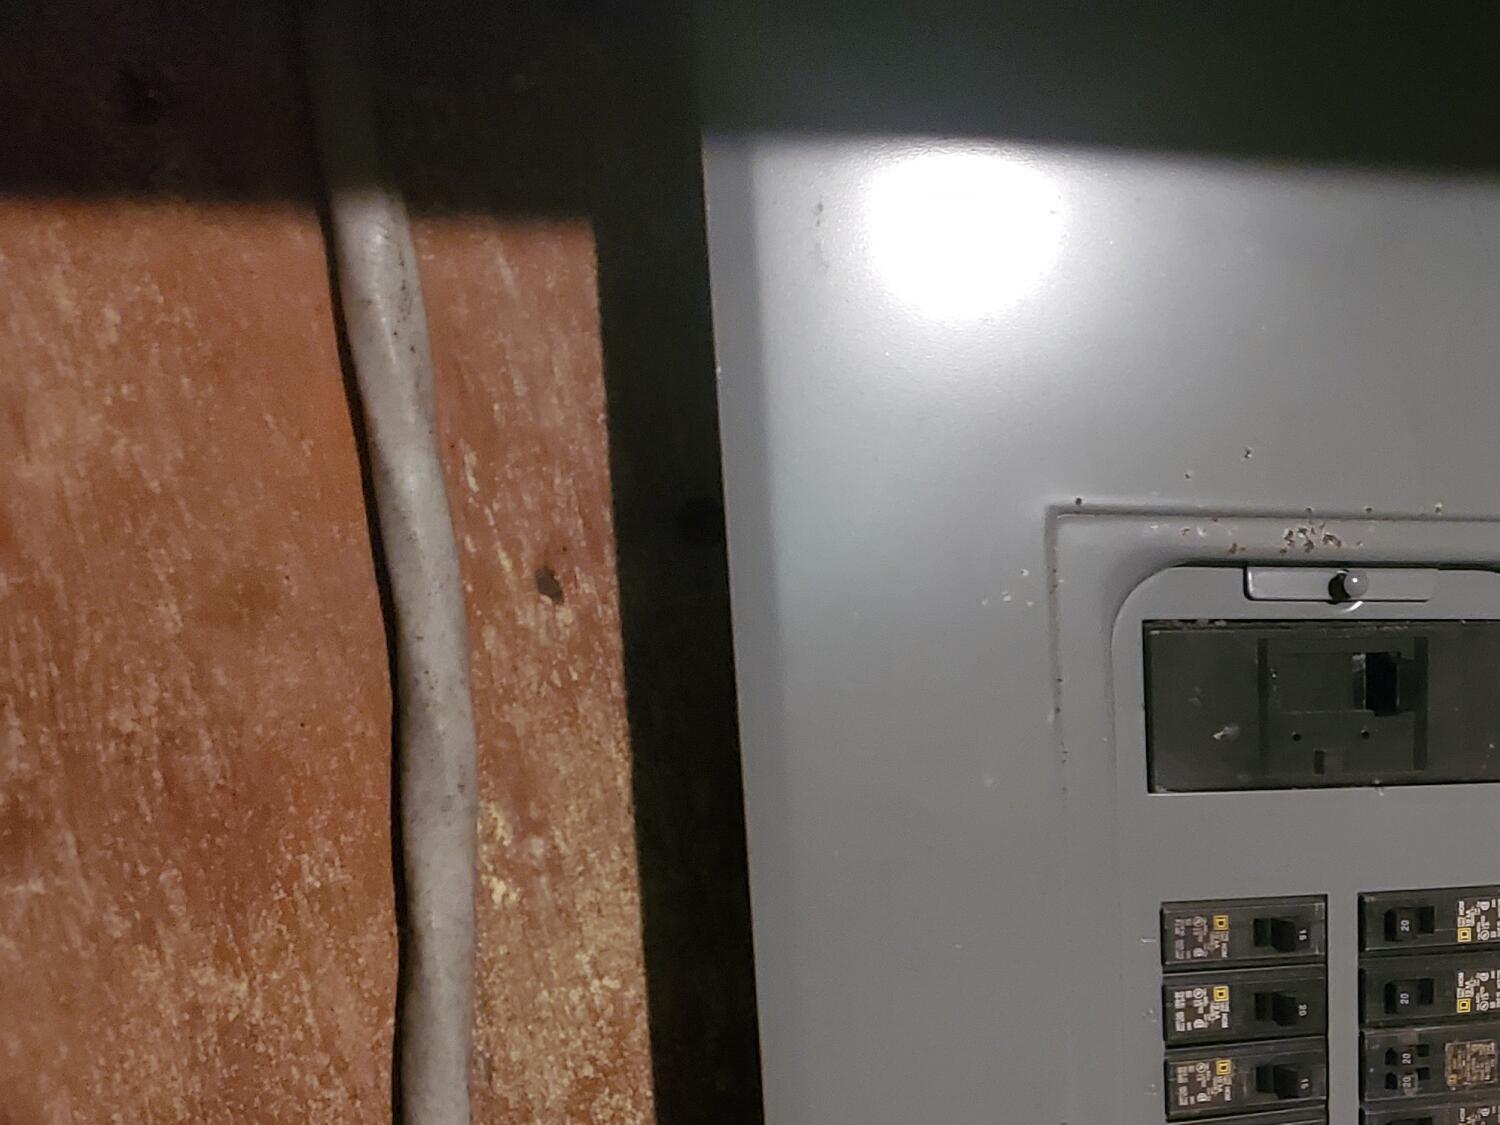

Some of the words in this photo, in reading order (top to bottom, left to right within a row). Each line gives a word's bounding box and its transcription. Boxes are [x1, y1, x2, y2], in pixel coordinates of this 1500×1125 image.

[1401, 920, 1409, 932] 20
[1400, 993, 1409, 1004] 20
[1299, 1005, 1306, 1016] 20
[1402, 1053, 1411, 1064] 20
[1402, 1077, 1411, 1087] 20
